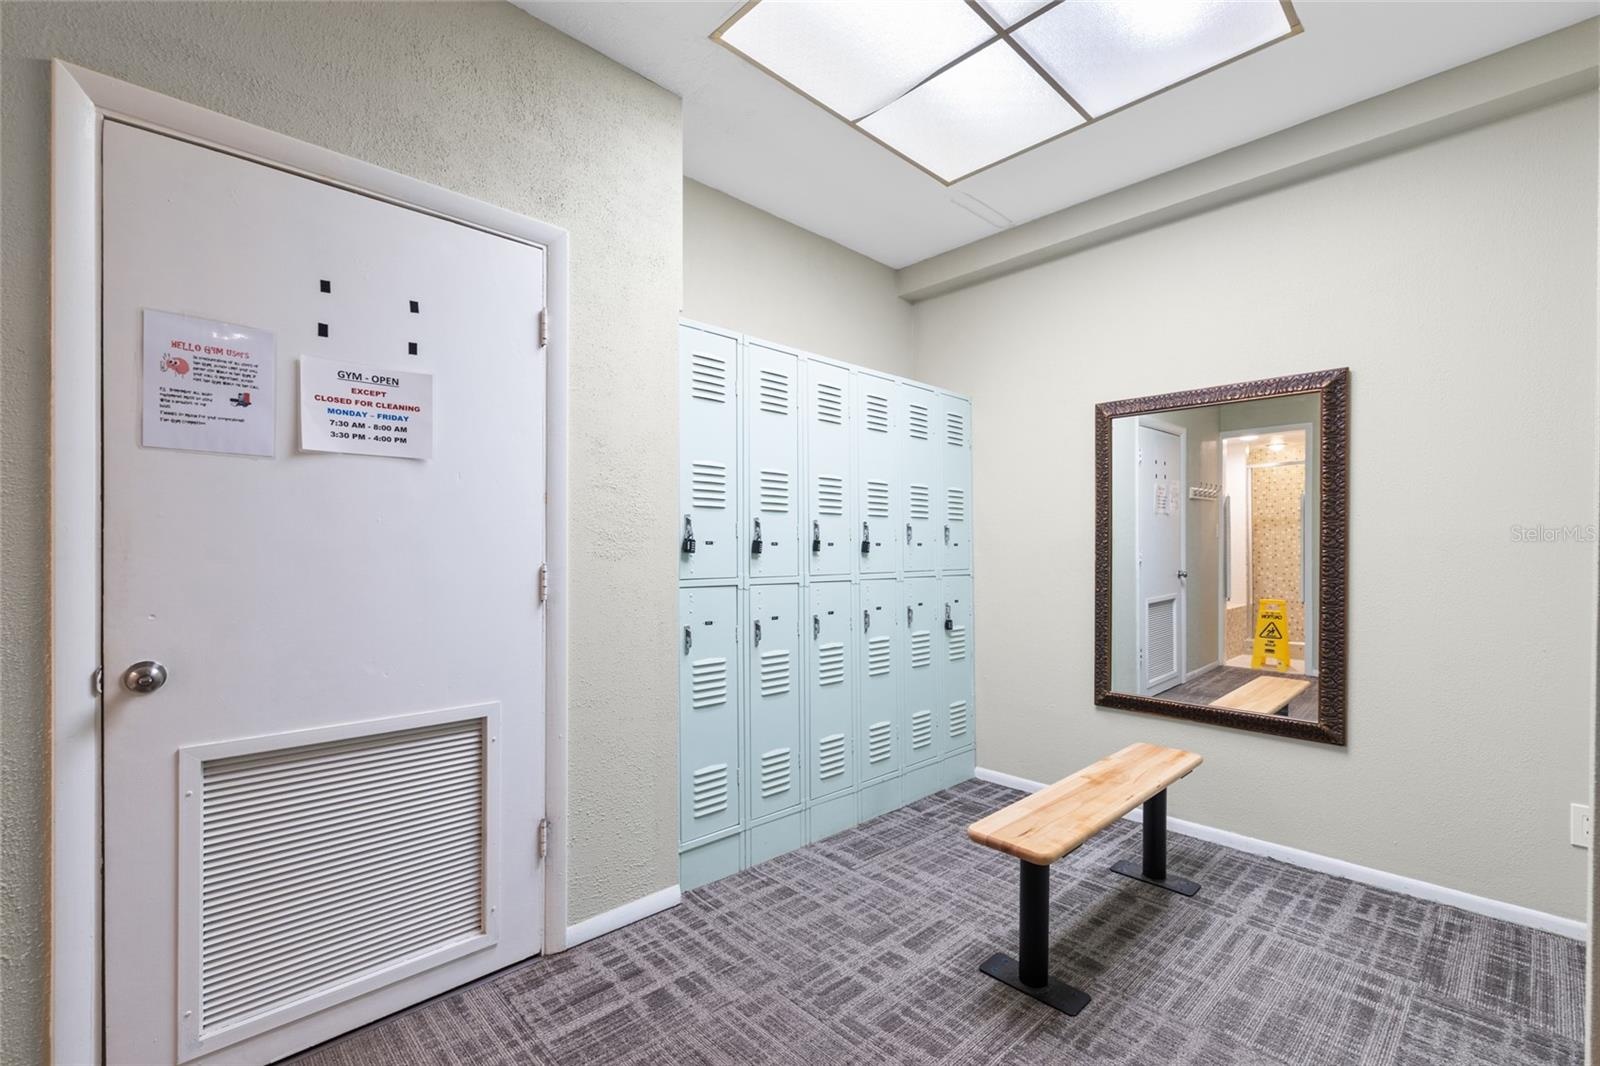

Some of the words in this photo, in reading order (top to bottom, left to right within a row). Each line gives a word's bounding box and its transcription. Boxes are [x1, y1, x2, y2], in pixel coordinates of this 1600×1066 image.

[171, 340, 201, 352] HELLO
[204, 346, 224, 355] GYM
[337, 370, 362, 380] GYM
[371, 375, 399, 386] OPEN
[351, 388, 387, 398] EXCEPT
[314, 394, 352, 405] CLOSED
[355, 399, 373, 407] FOR
[376, 401, 421, 412] CLEANING
[327, 408, 368, 418] MONDAY
[377, 413, 409, 422] FRIDAY
[330, 419, 349, 427] 7:30
[351, 421, 365, 429] AM
[330, 431, 349, 439] 3:30
